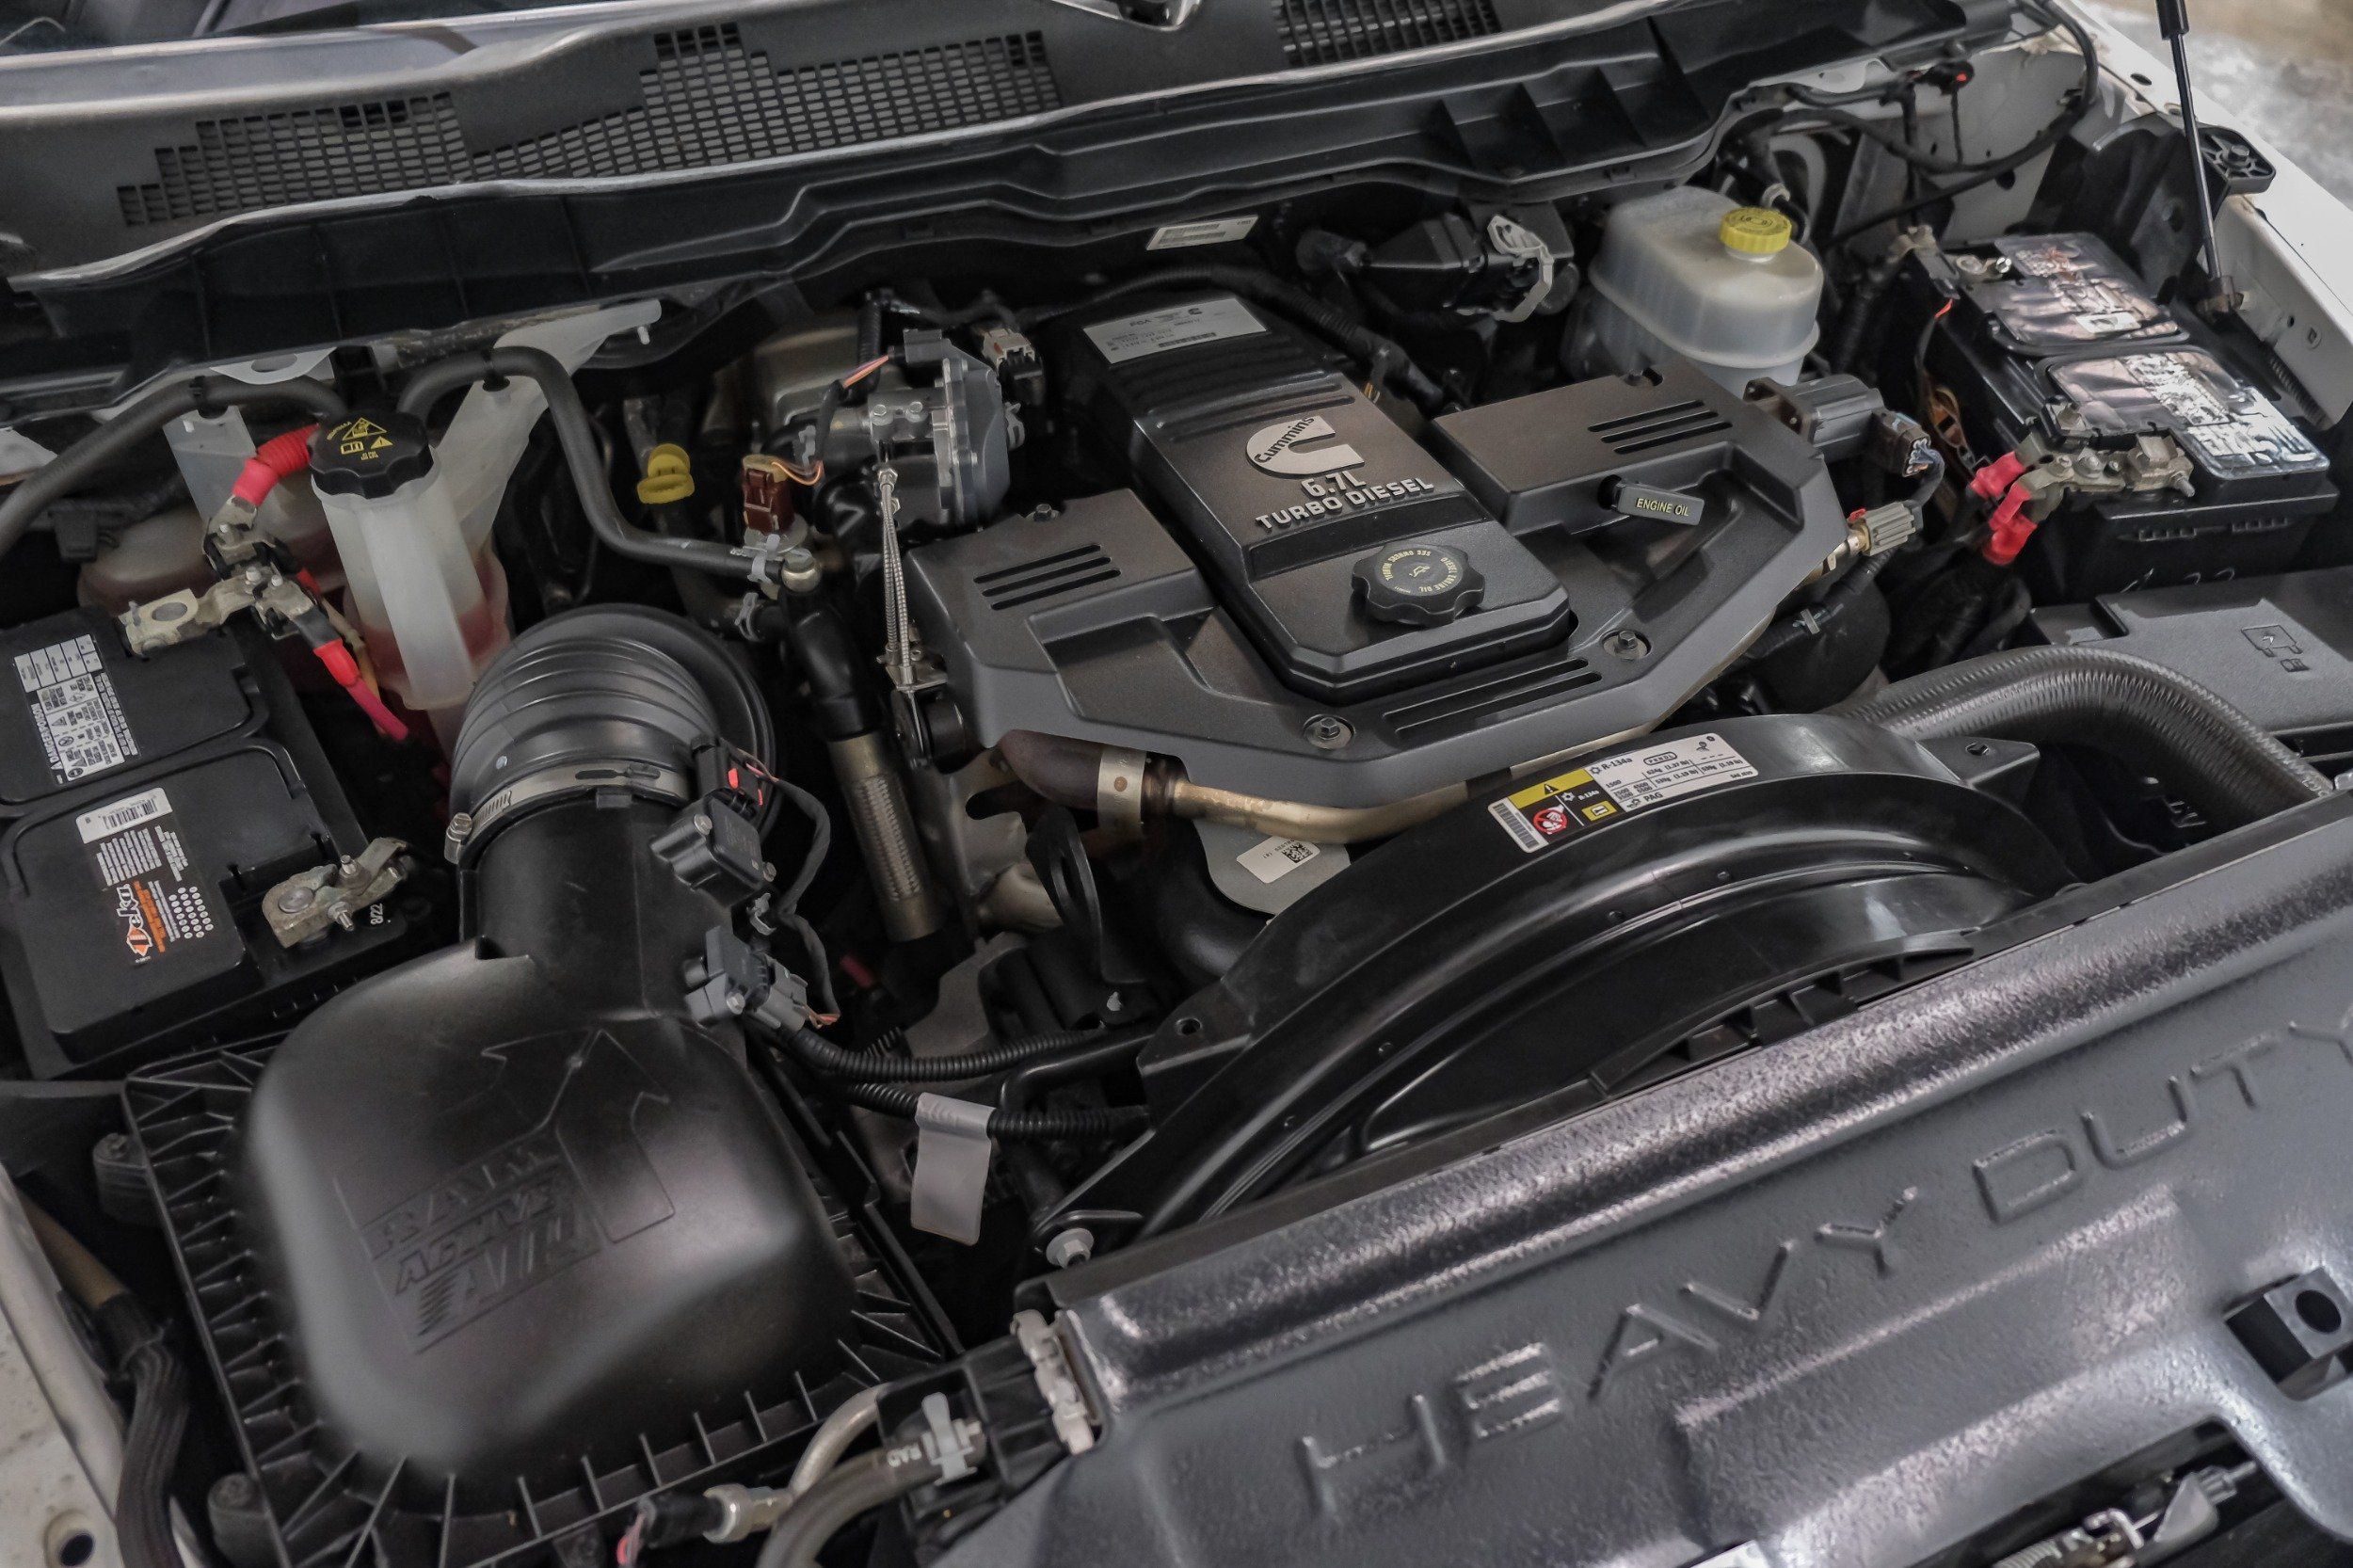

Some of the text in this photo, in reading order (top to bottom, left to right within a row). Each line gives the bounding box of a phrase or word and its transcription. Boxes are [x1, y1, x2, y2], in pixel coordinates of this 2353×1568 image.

[1254, 417, 1315, 464] Cummins
[1301, 471, 1367, 497] 6.7L
[1255, 477, 1434, 529] TURBO DIESEL
[1636, 498, 1689, 517] ENGINE OIL
[1601, 758, 1633, 770] R-134a
[1643, 792, 1664, 802] PAG
[1300, 1005, 2353, 1517] HEAVY DUTY
